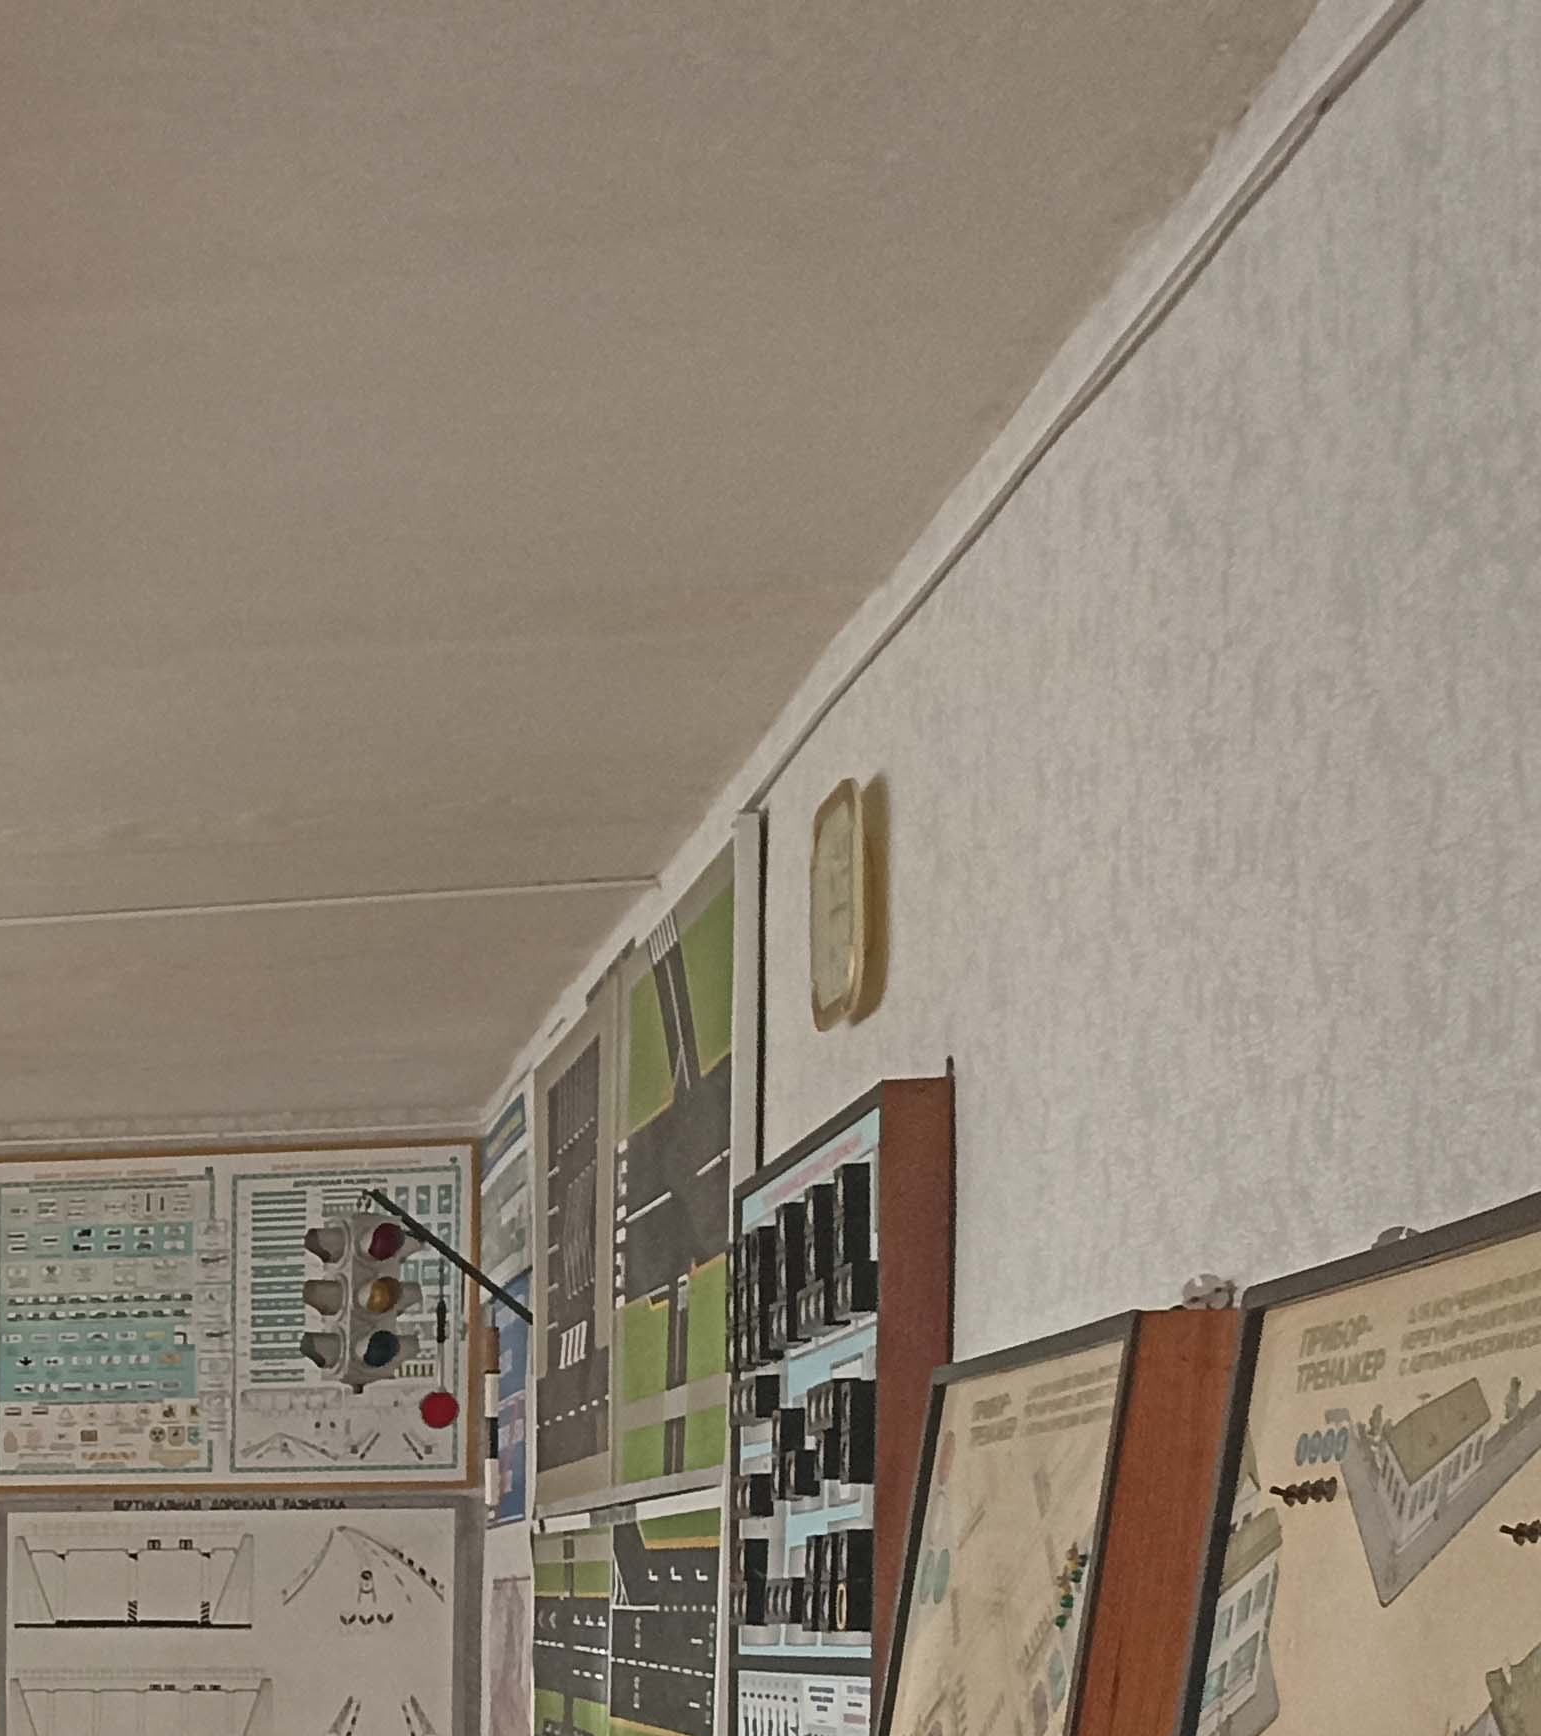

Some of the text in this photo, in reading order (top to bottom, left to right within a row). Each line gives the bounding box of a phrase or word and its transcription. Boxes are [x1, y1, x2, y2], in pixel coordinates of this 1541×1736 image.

[1299, 1314, 1374, 1359] ПРИБОР-
[1296, 1348, 1386, 1393] ТРЕНАЖЕР
[113, 1498, 347, 1511] ВЕРТИКАЛЬНАЯ ДОРОЖНАЯ РАЗМЕТКА
